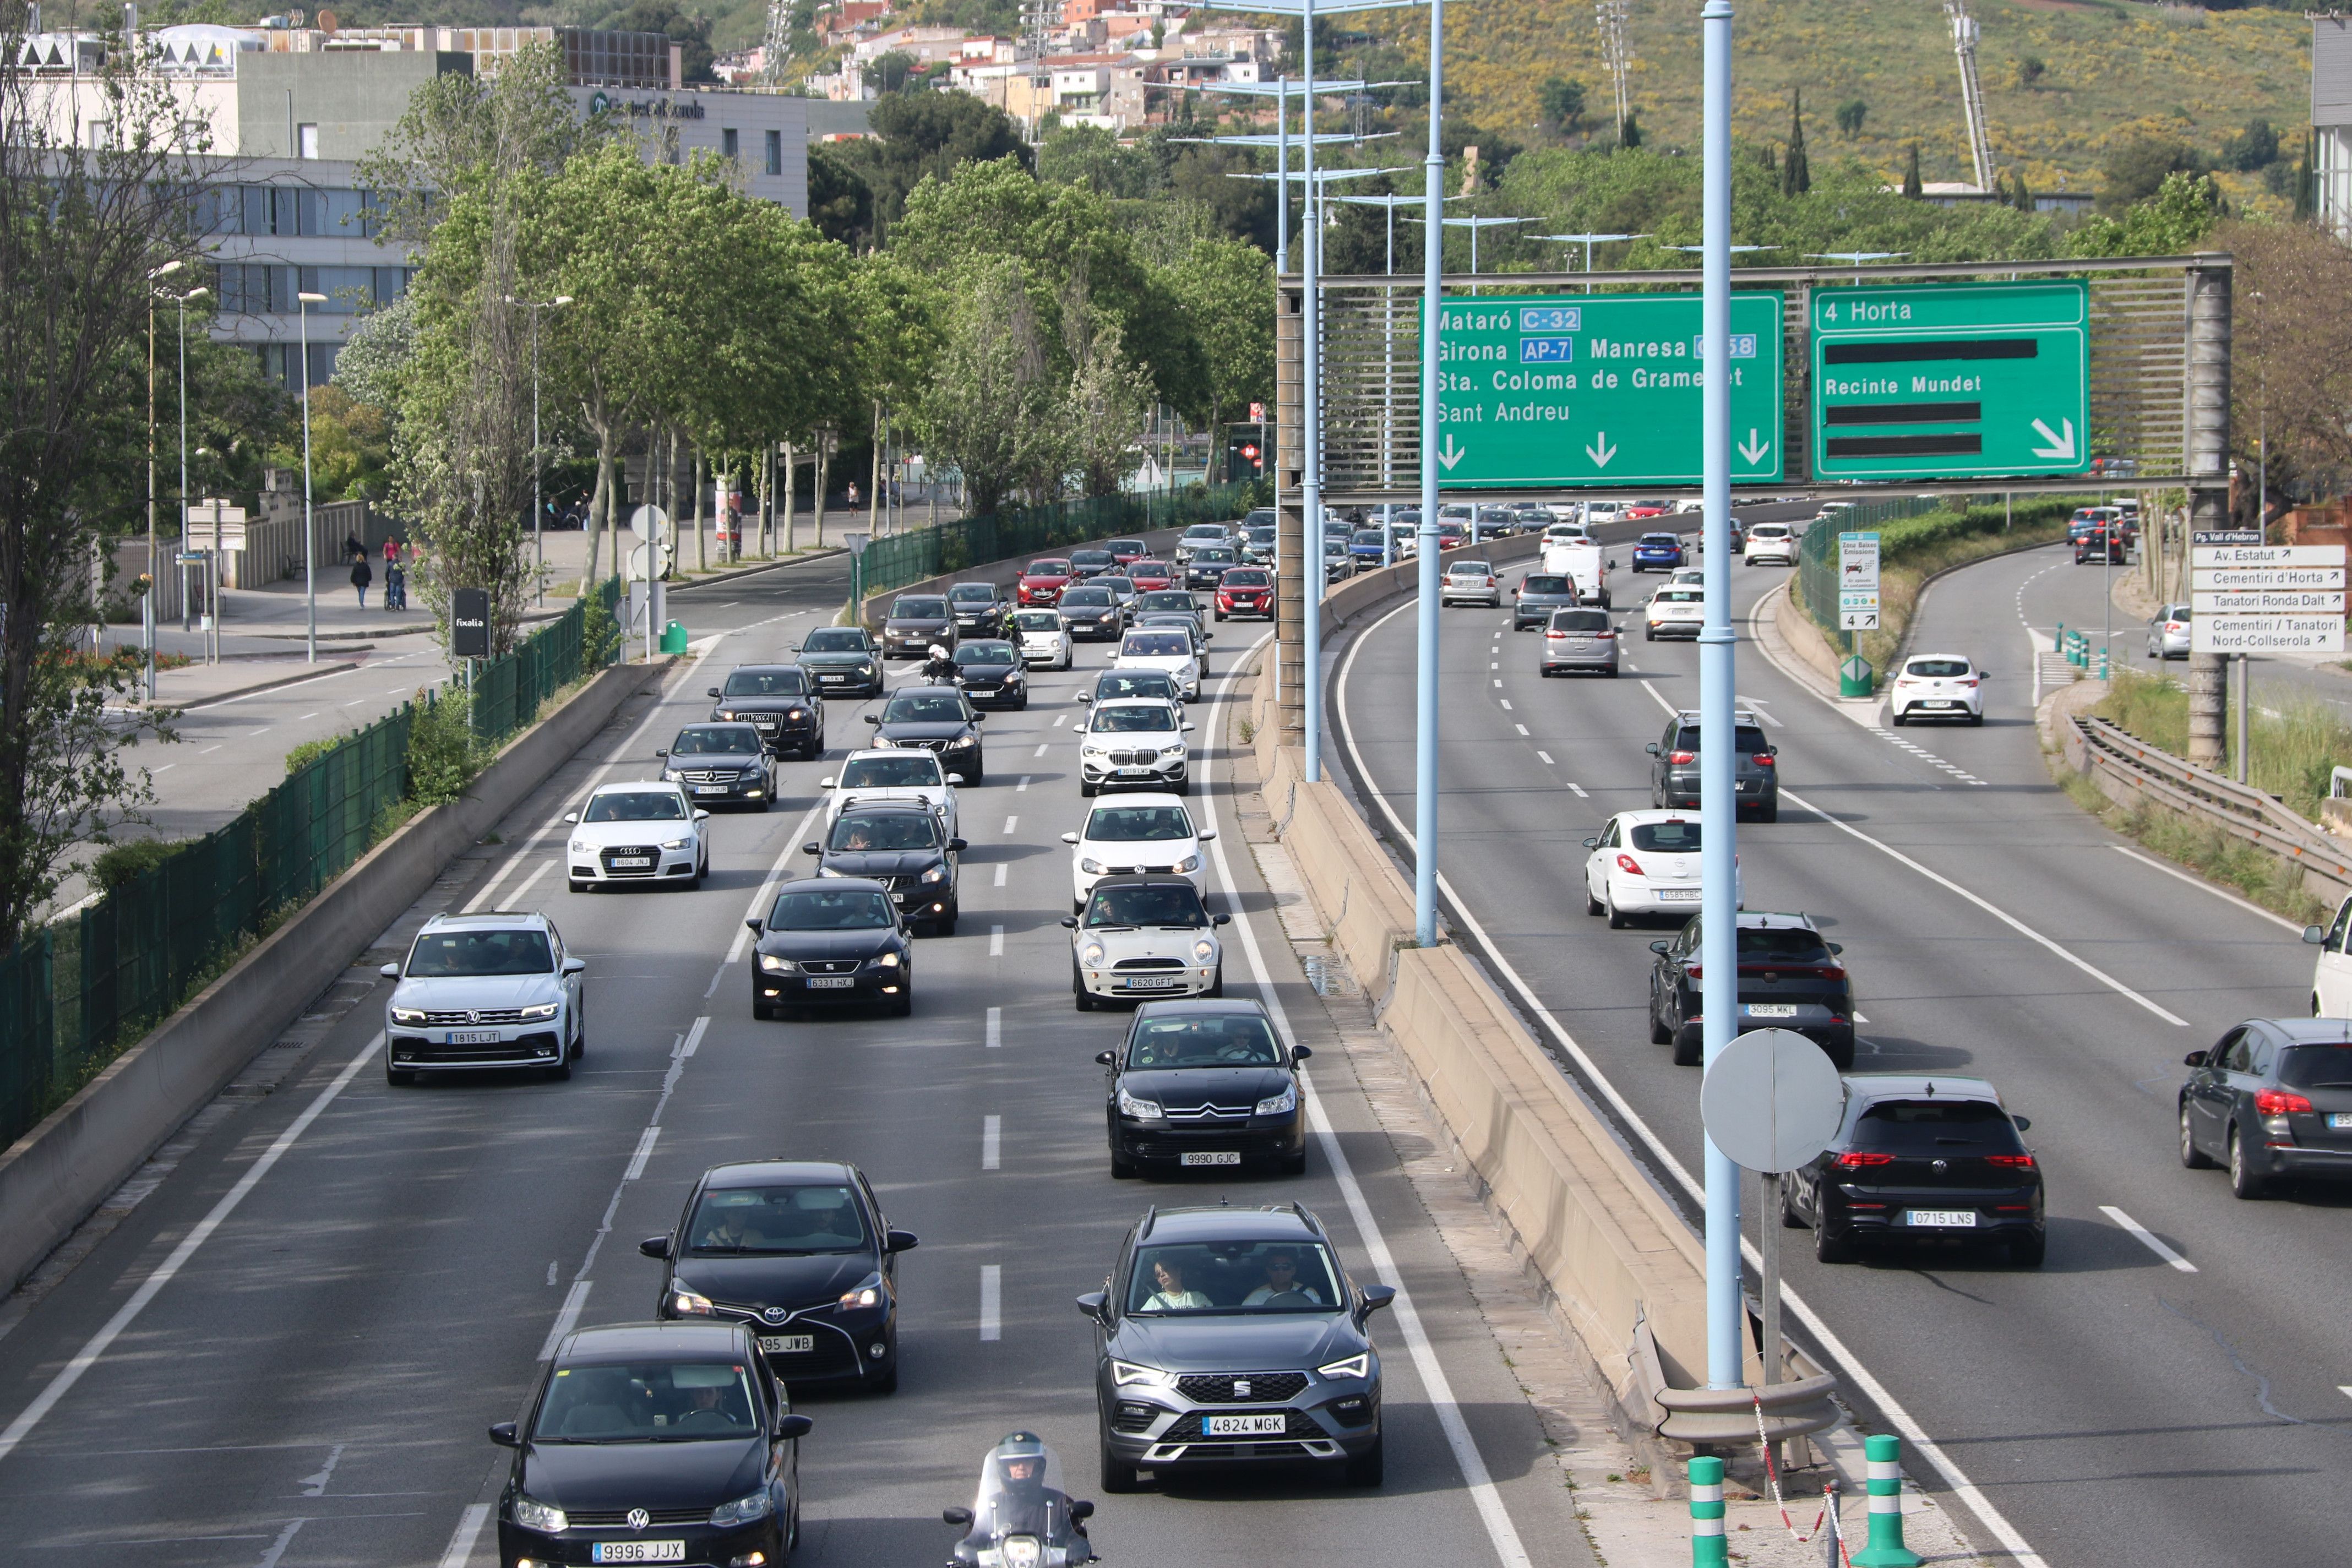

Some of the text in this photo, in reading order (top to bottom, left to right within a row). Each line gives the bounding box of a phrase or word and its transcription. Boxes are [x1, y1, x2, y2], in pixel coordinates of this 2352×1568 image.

[1825, 301, 1911, 321] 4 Horta
[1440, 310, 1577, 330] Mataró C-32
[1439, 337, 1752, 361] Girona AP-7 Manresa 58
[1439, 367, 1743, 391] Sta. Coloma de Gramet
[1826, 375, 1981, 395] Recinte Mundet
[1439, 402, 1569, 422] Sant Andreu
[2196, 532, 2259, 542] Pg. Vall d'Hebron
[2214, 549, 2275, 560] Av. Estatut
[2213, 571, 2323, 584] Cementiri d'Horta
[2213, 595, 2325, 606] Tanatori Ronda Dalt
[1848, 615, 1855, 626] 4
[2213, 619, 2272, 630] Cementiri
[2286, 619, 2337, 630] Tanatori
[2213, 635, 2311, 646] Nord-Collserola
[1751, 1005, 1794, 1014] 3095 MKL
[455, 1033, 496, 1042] 1815 LJT
[1188, 1154, 1234, 1163] 9990 GJC
[1916, 1213, 1972, 1224] 0715 LNS
[786, 1337, 809, 1349] JWB
[1213, 1418, 1281, 1431] 4824 MGK
[603, 1543, 680, 1559] 9996 JJX
